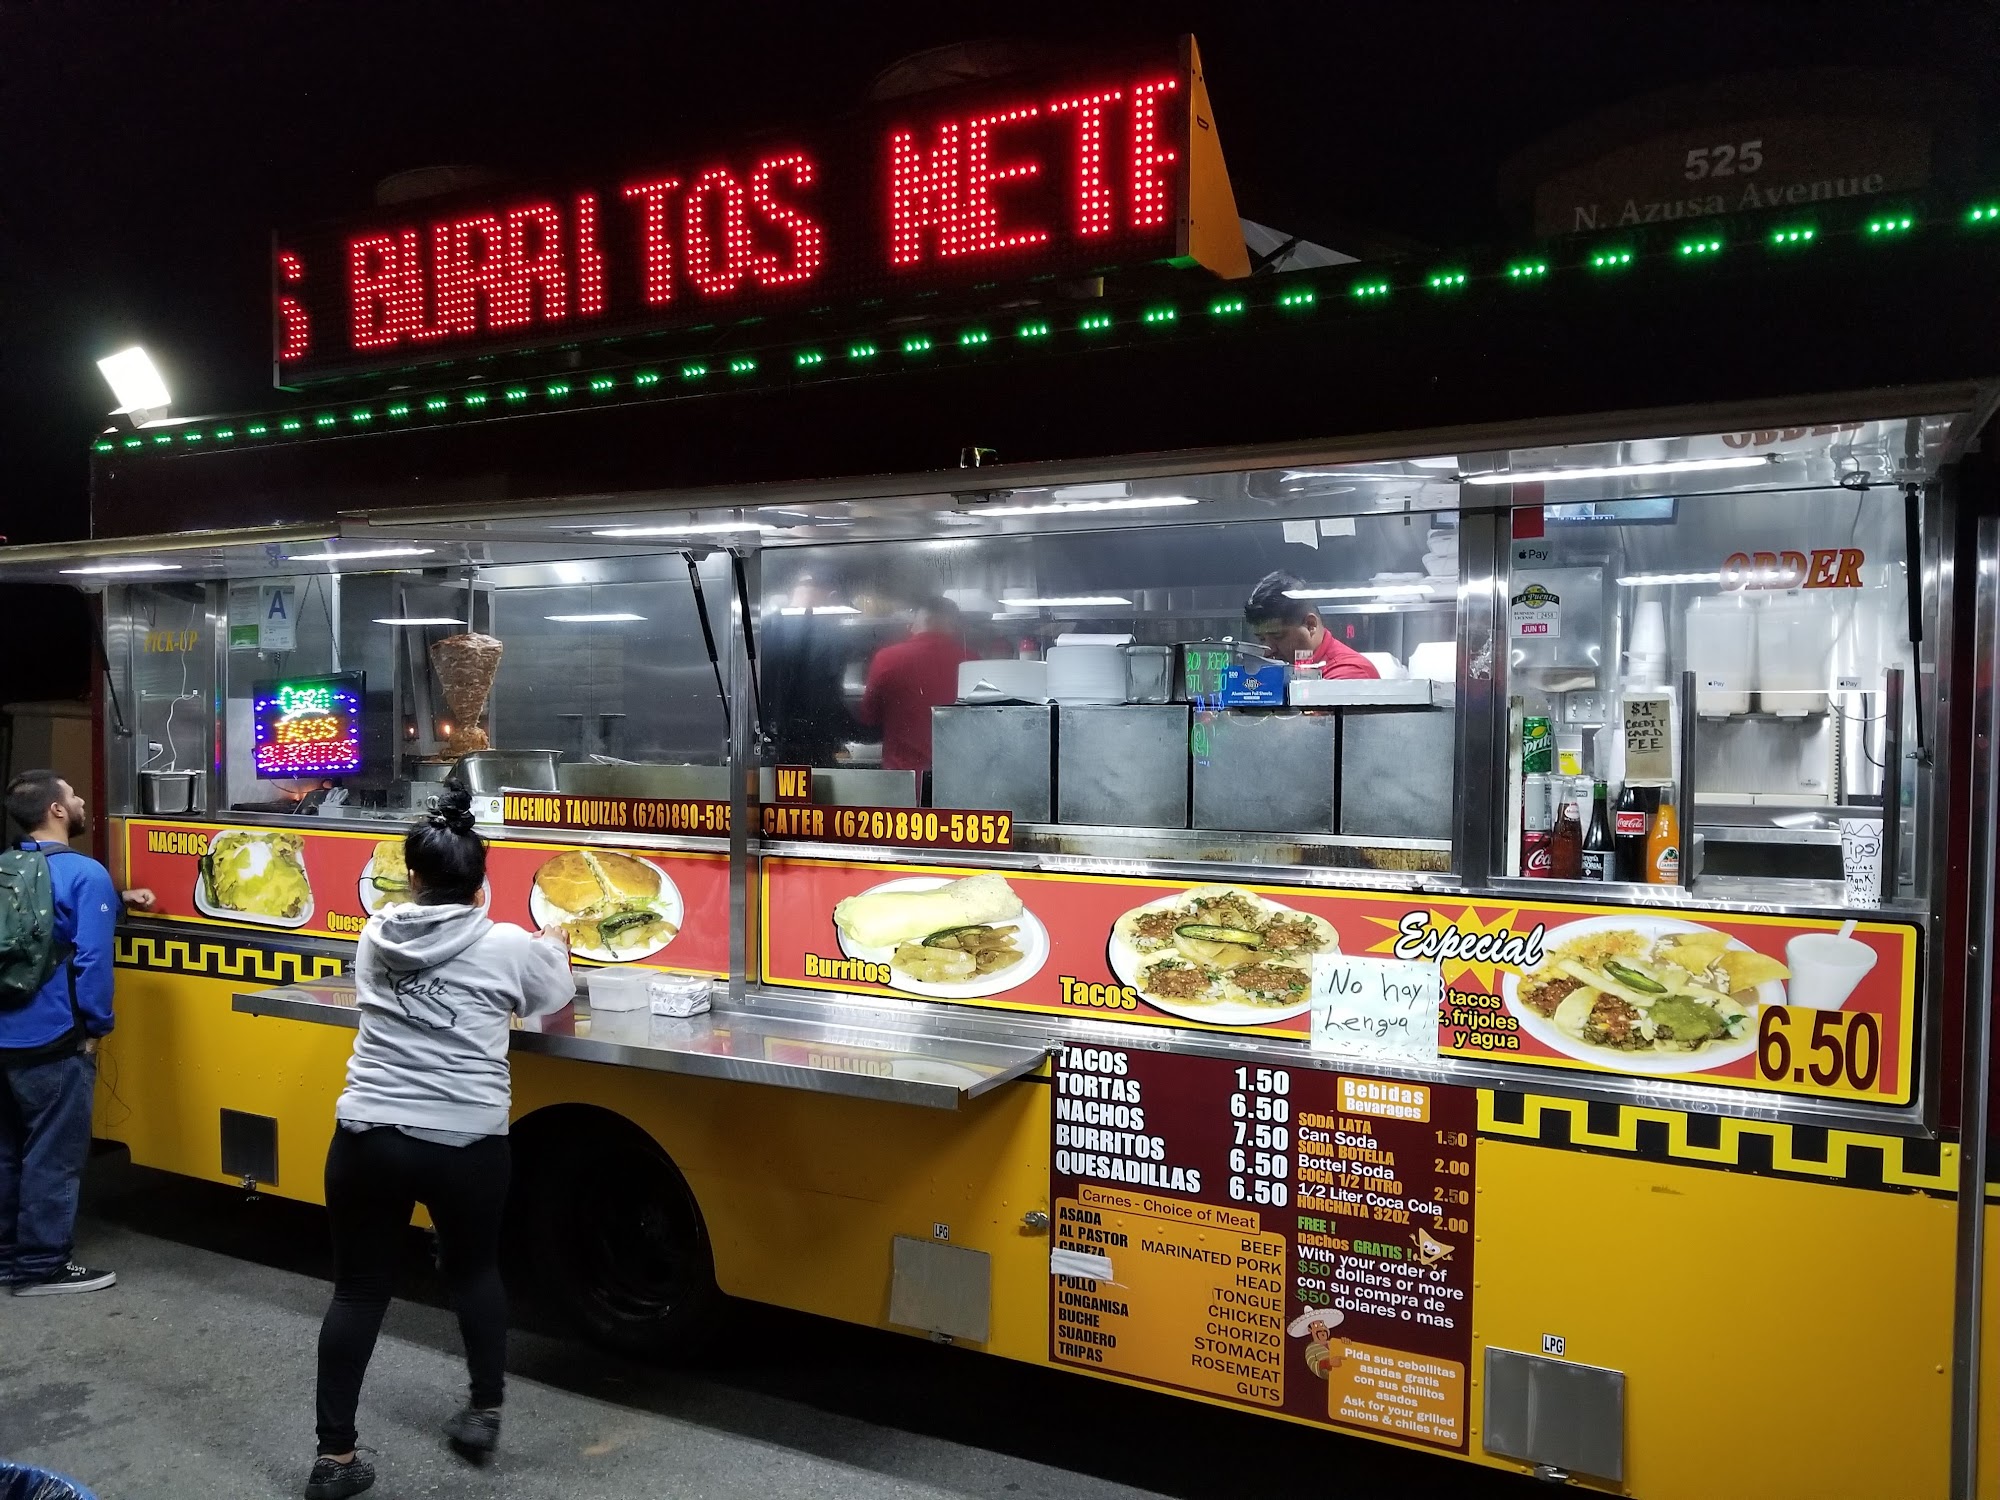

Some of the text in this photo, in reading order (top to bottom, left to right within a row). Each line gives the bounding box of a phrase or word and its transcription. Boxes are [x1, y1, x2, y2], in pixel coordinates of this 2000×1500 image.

[1684, 140, 1764, 182] 525
[1573, 172, 1885, 233] N. Azusa Avenue
[352, 154, 823, 350] BURRITOS
[1528, 549, 1549, 561] Pay
[1720, 548, 1866, 592] ORDER
[268, 590, 287, 620] A
[144, 630, 198, 654] PICK-UP
[1523, 624, 1547, 633] JUN 18
[274, 717, 338, 743] TACOS
[260, 740, 352, 768] BURRITOS
[1627, 738, 1664, 750] FEE
[778, 770, 807, 797] WE
[504, 796, 561, 826] HACEMOS
[566, 799, 627, 827] TAQUIZAS
[763, 807, 1012, 845] CATER (626)890-5852
[148, 830, 208, 857] NACHOS
[1394, 911, 1545, 966] Especial
[805, 954, 891, 985] Burritos
[395, 975, 448, 997] Cali
[1059, 976, 1138, 1011] Tacos
[1328, 968, 1363, 995] No
[1381, 972, 1423, 1010] hay
[1448, 988, 1501, 1010] tacos
[1324, 1004, 1411, 1038] Lengua
[1452, 1008, 1519, 1031] frijoles
[1454, 1031, 1519, 1051] y agua
[1758, 1005, 1880, 1091] 6.50
[1058, 1046, 1290, 1095] TACOS 1.50
[1056, 1072, 1289, 1123] TORTAS 6.50
[1344, 1080, 1424, 1105] Bebidas
[1346, 1098, 1422, 1119] Bevarages
[1056, 1098, 1289, 1151] NACHOS 7.50
[1298, 1112, 1372, 1135] SODA LATA
[1056, 1124, 1289, 1179] BURRITOS 6.50
[1298, 1127, 1468, 1150] Can Soda 1.50
[1298, 1140, 1395, 1166] SODA BOTELLA
[1056, 1150, 1288, 1207] QUESADILLAS 6.50
[1298, 1154, 1470, 1180] Bottel Soda 2.00
[1298, 1167, 1403, 1195] COCA 1/2 LITRO
[1082, 1189, 1256, 1230] Carnes Choice of Meat
[1298, 1182, 1469, 1216] 1/2 Liter Coca Cola 2.50
[1059, 1206, 1102, 1226] ASADA
[1297, 1195, 1370, 1219] HORCHATA
[1433, 1216, 1469, 1234] 2.00
[1298, 1216, 1327, 1233] FREE
[935, 1225, 948, 1239] LPG
[1059, 1223, 1129, 1248] AL PASTOR
[1141, 1239, 1282, 1276] MARINATED PORK
[1241, 1239, 1283, 1257] BEEF
[1298, 1232, 1349, 1251] nachos
[1353, 1239, 1403, 1260] GRATIS
[1297, 1245, 1448, 1283] With your order of
[1059, 1274, 1097, 1293] POLLO
[1235, 1274, 1282, 1293] HEAD
[1297, 1259, 1464, 1301] $50 dollars or more
[1058, 1291, 1129, 1317] LONGANISA
[1215, 1287, 1282, 1312] TONGUE
[1297, 1276, 1446, 1312] con su compra de
[1058, 1307, 1100, 1328] BUCHE
[1208, 1305, 1281, 1330] CHICKEN
[1296, 1288, 1455, 1329] $50 dolares o mas
[1058, 1325, 1117, 1348] SUADERO
[1206, 1322, 1281, 1348] CHORIZO
[1544, 1336, 1563, 1353] LPG
[1058, 1341, 1103, 1363] TRIPAS
[1194, 1336, 1281, 1366] STOMACH
[1344, 1347, 1456, 1379] Pida sus cebollitas
[1191, 1354, 1281, 1384] ROSEMEAT
[1360, 1364, 1440, 1388] asadas gratis
[1236, 1382, 1280, 1402] GUTS
[1354, 1375, 1375, 1386] con
[1378, 1380, 1398, 1391] sus
[1343, 1395, 1455, 1427] Ask for your grilled
[1375, 1391, 1418, 1407] asados
[1340, 1407, 1458, 1440] onions & chiles free
